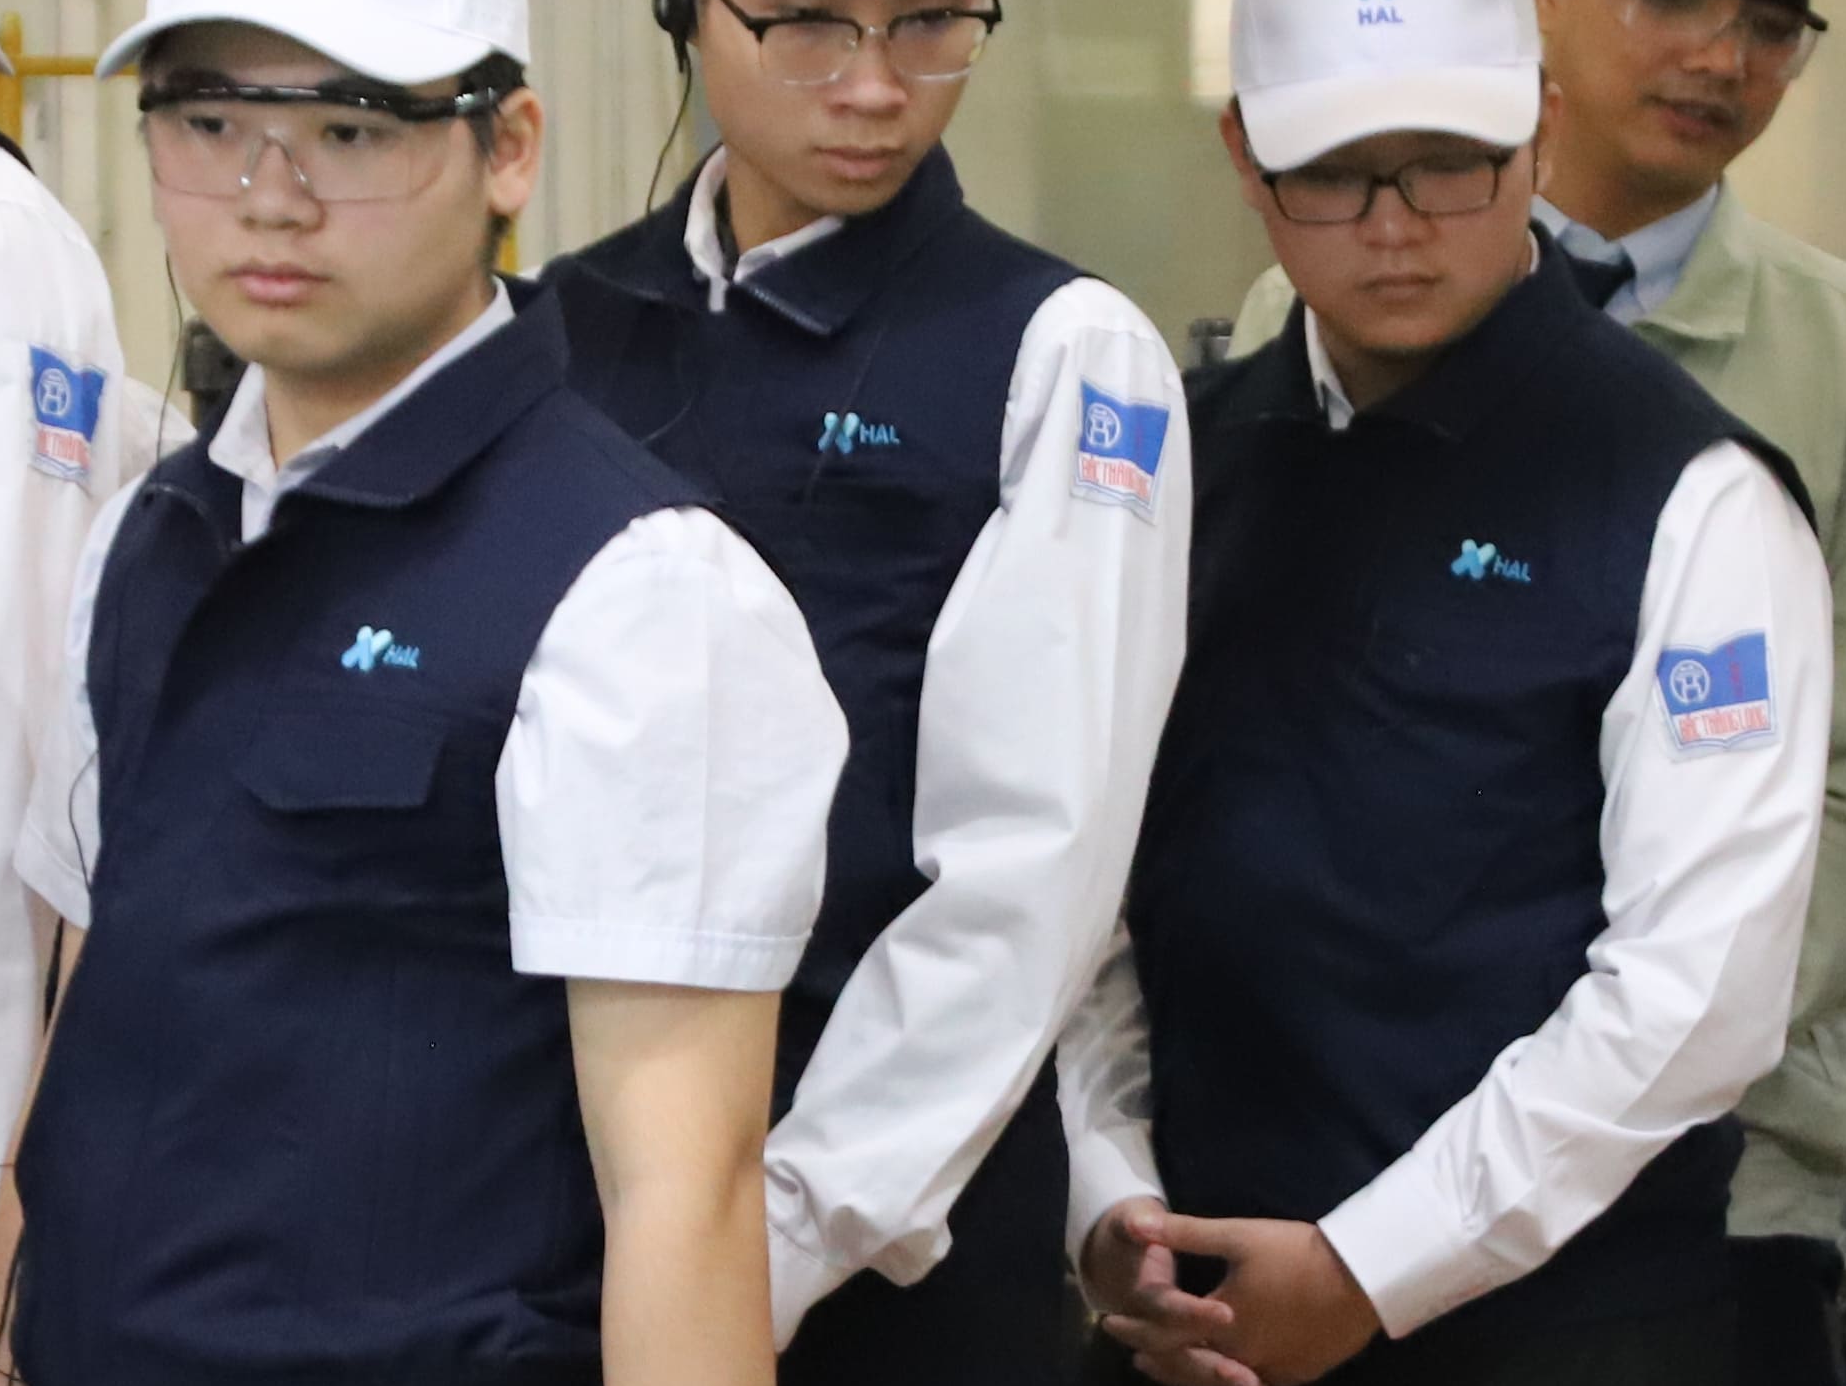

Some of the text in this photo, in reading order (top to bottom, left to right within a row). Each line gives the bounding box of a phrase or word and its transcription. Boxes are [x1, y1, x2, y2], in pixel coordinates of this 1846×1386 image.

[1357, 6, 1404, 26] HAL
[859, 423, 901, 445] HAL
[1493, 555, 1532, 582] HAL
